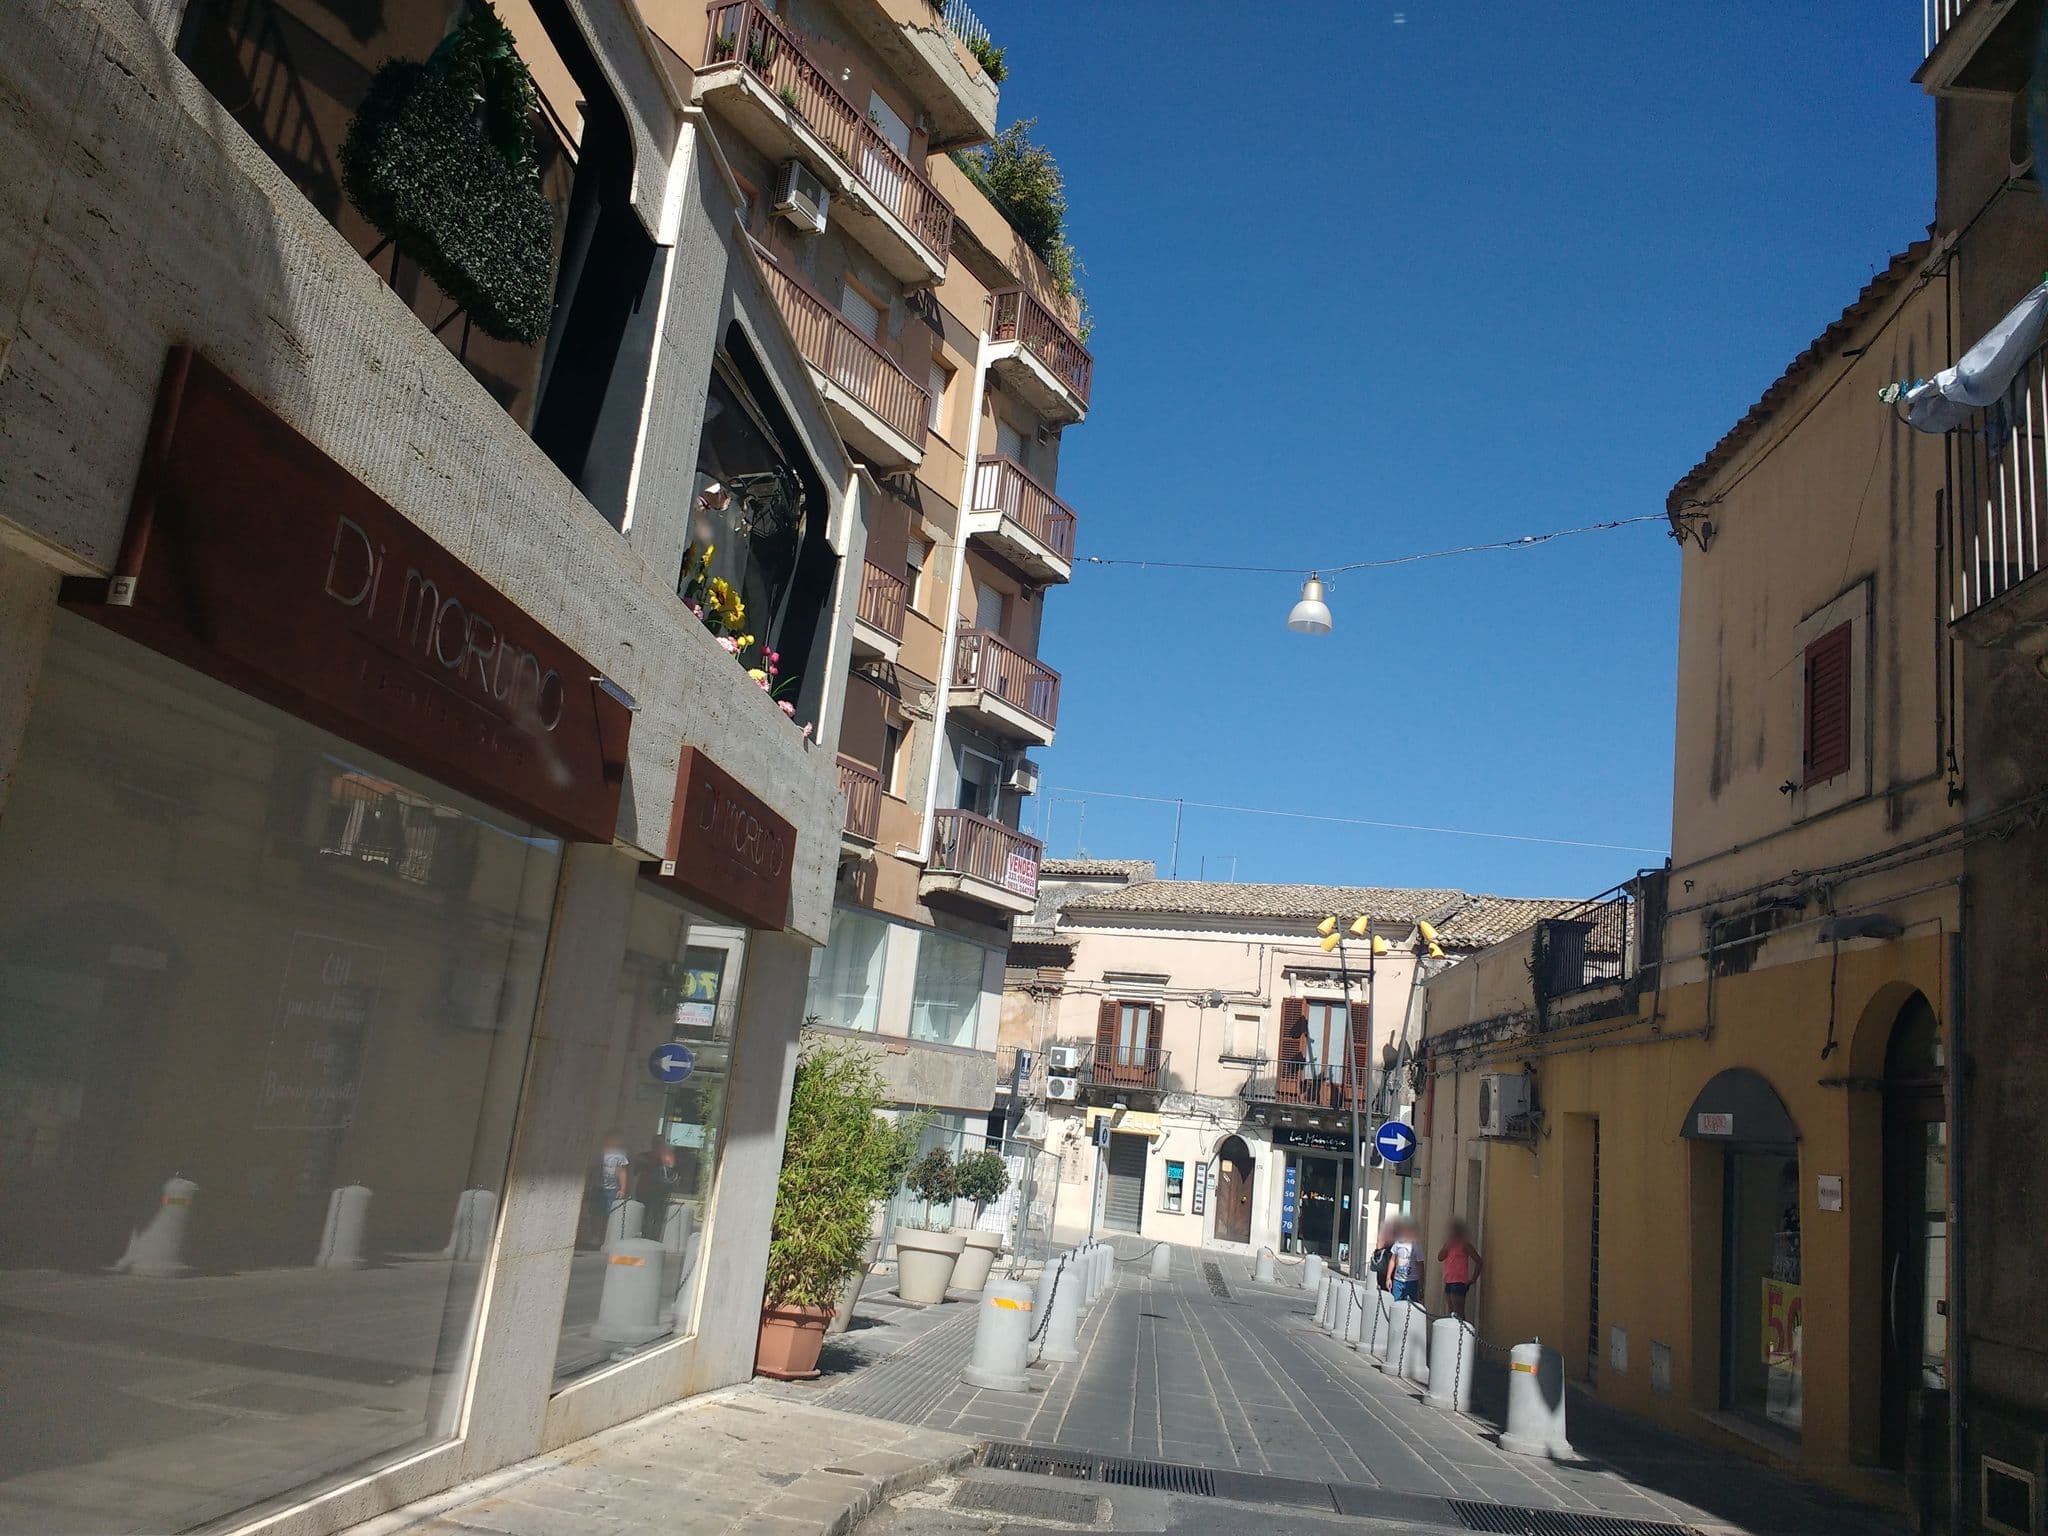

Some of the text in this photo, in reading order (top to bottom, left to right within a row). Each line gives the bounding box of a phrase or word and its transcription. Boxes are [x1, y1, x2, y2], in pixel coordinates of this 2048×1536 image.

[325, 514, 387, 621] Di
[1010, 854, 1036, 880] VENDESI
[1289, 1130, 1347, 1146] La Miniera
[1284, 1190, 1295, 1199] 50
[1283, 1204, 1294, 1213] 60
[1282, 1220, 1293, 1230] 70
